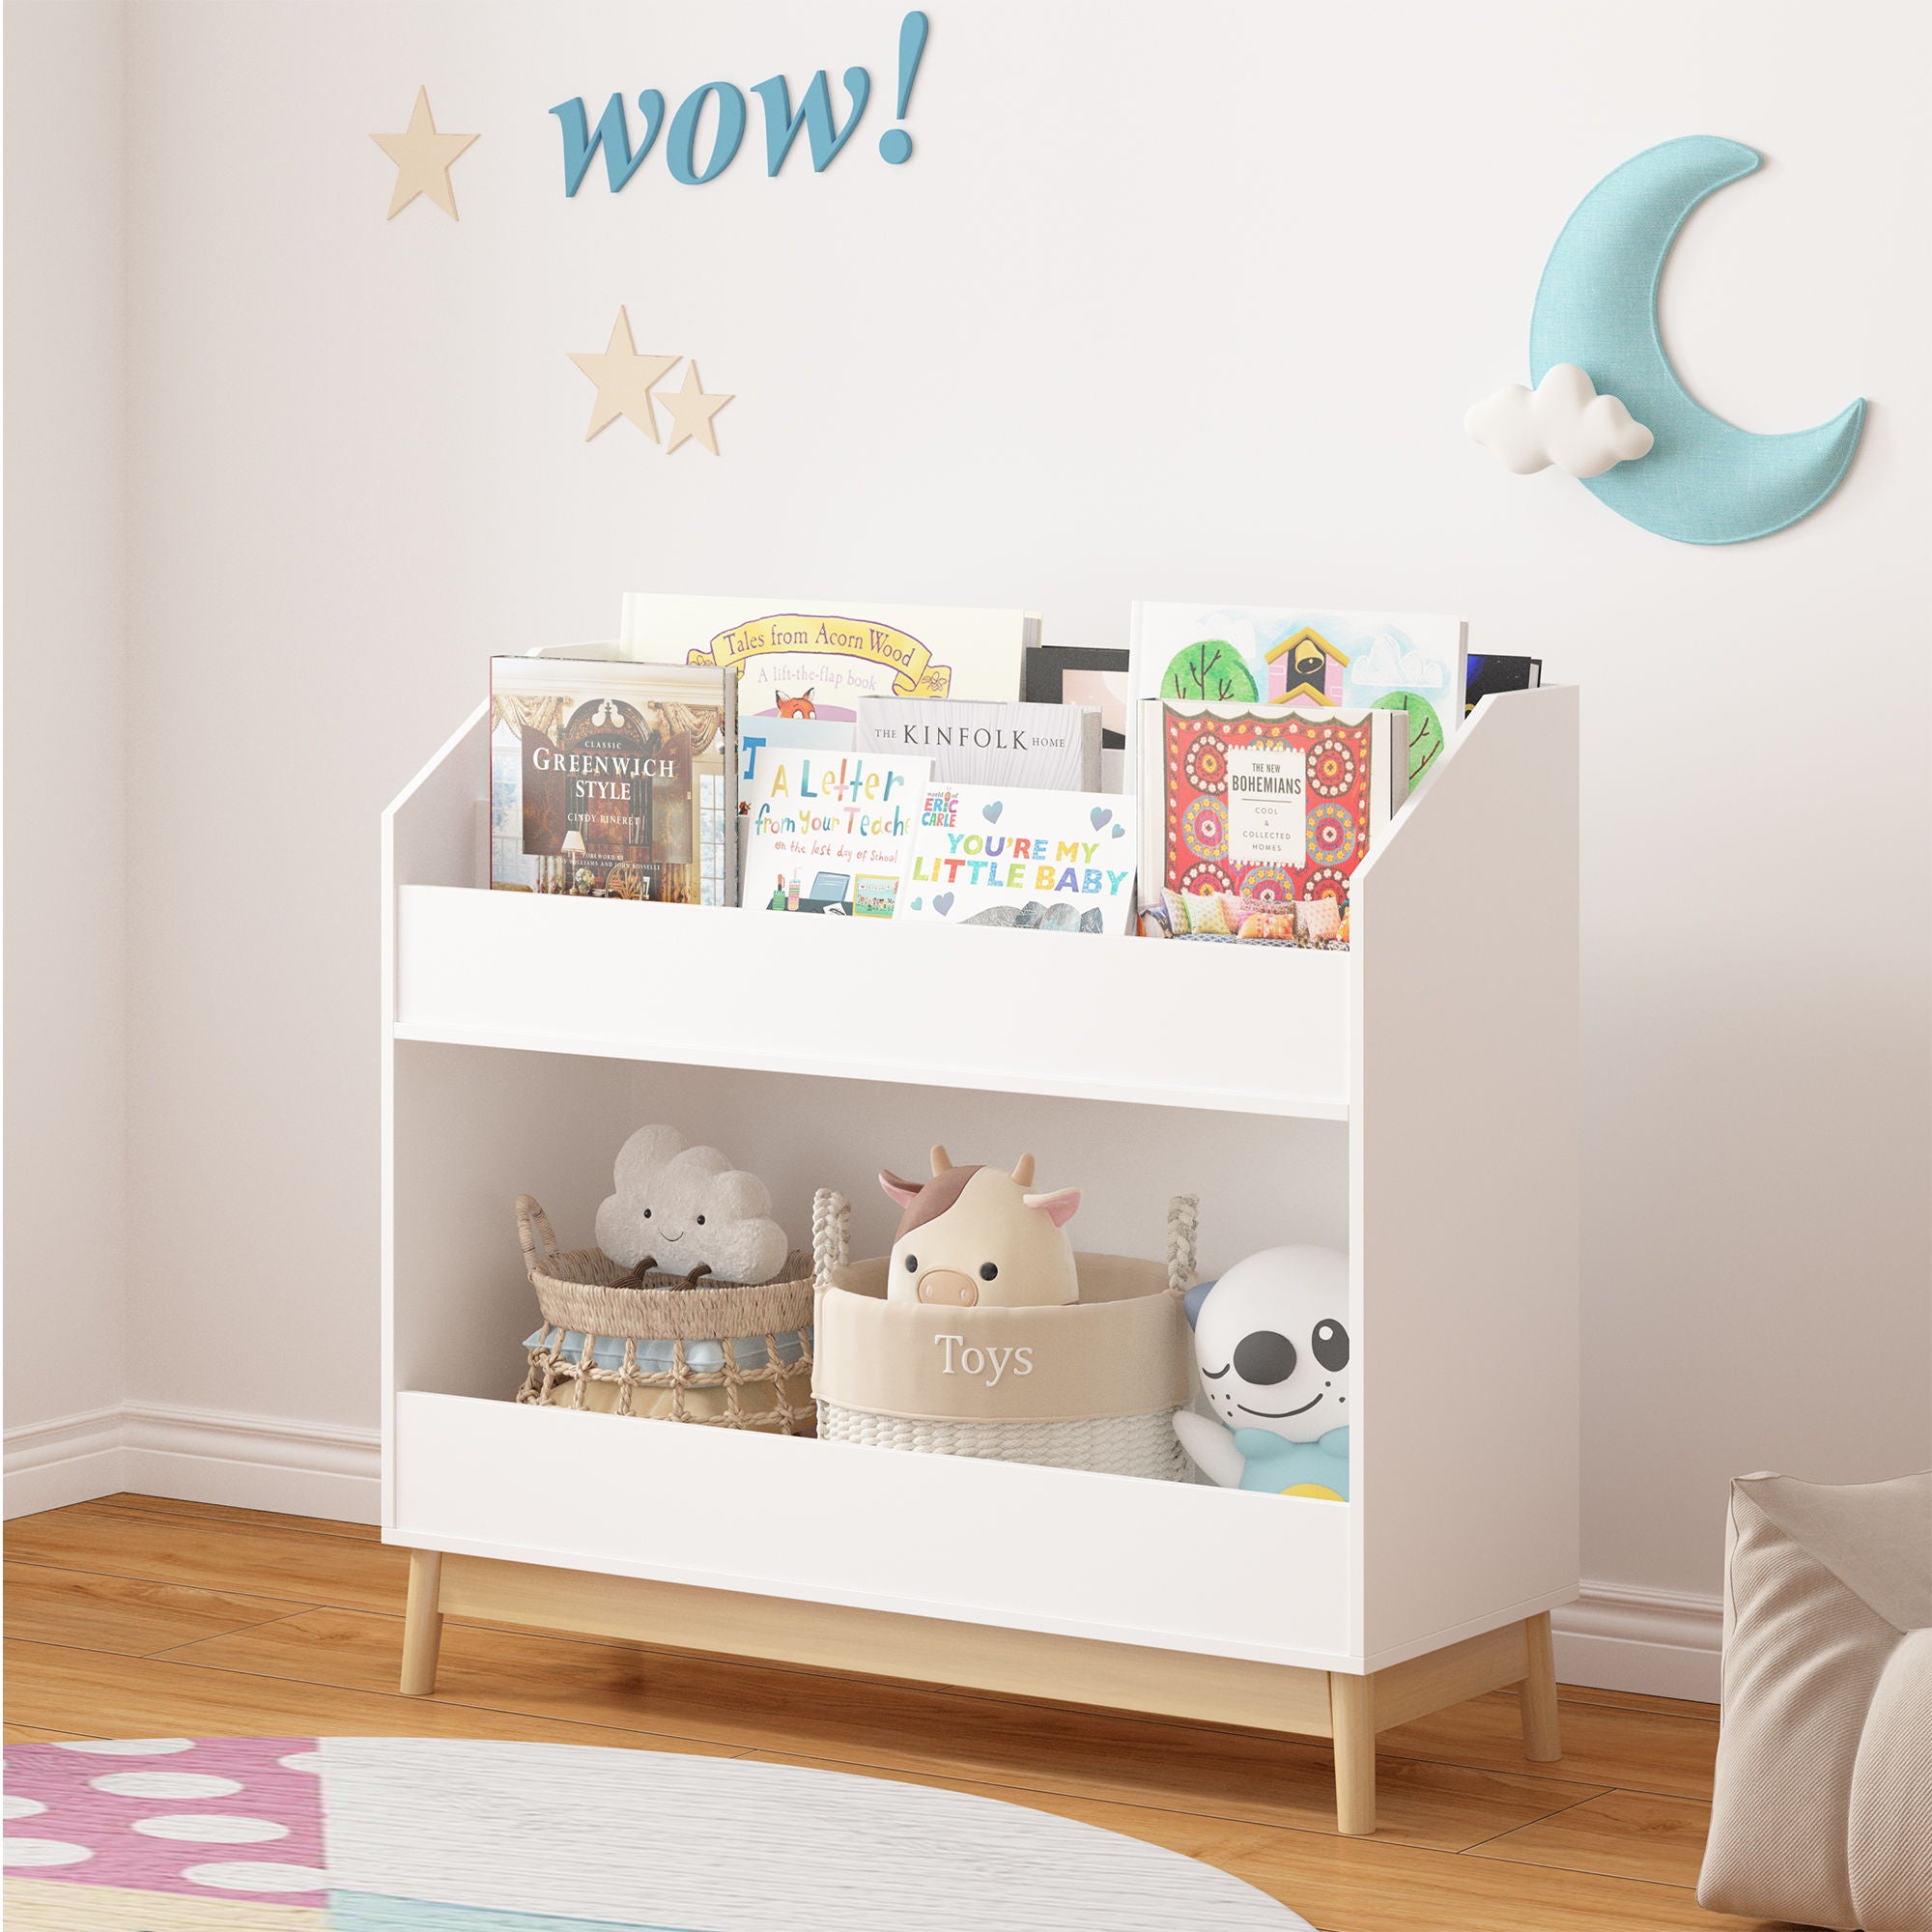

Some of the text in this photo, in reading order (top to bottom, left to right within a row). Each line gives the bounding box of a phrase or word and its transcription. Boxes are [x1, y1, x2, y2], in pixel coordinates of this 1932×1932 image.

[548, 11, 929, 198] wow!
[723, 622, 917, 668] Tales from Acorn Wood
[757, 665, 878, 691] A lift-the-flap book
[584, 740, 622, 750] CLASSIC
[875, 724, 1065, 751] THE KINFOLK HOME
[532, 747, 675, 778] GREENWICH
[1252, 762, 1281, 774] THE NEW
[575, 780, 631, 801] STYLE
[771, 757, 905, 803] A Letter
[1232, 775, 1302, 795] BOHEMIANS
[567, 812, 640, 826] CINDY RINFRET
[754, 803, 796, 836] from
[922, 811, 957, 828] CARLE
[1255, 807, 1278, 815] COOL
[1242, 830, 1292, 840] COLLECTED
[1252, 843, 1282, 852] HOMES
[774, 840, 786, 850] on
[790, 839, 807, 854] the
[810, 839, 832, 856] last
[837, 844, 853, 863] day
[856, 849, 867, 862] of
[947, 833, 1100, 865] YOU'RE MY
[912, 856, 1026, 889] LITTLE
[1035, 865, 1129, 896] BABY
[934, 1333, 1035, 1387] Toys
